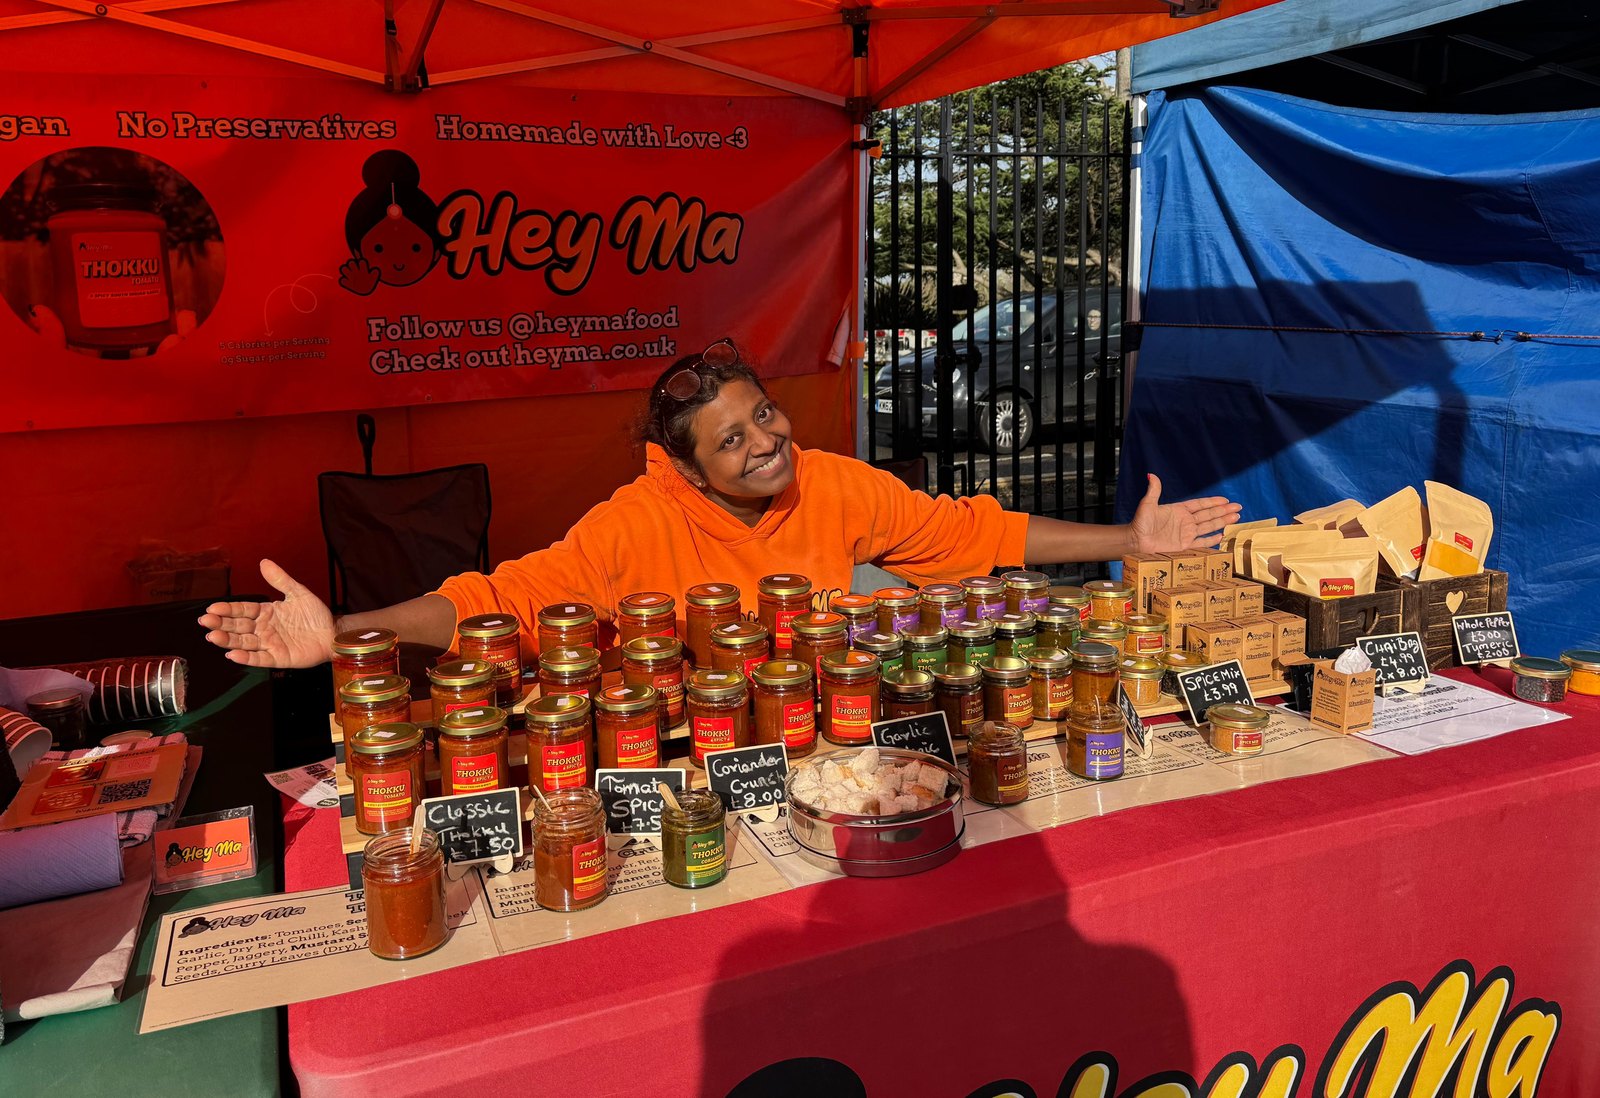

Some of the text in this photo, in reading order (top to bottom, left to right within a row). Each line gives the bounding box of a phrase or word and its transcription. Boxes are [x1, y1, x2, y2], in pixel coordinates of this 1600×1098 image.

[0, 113, 70, 141] gan
[116, 110, 396, 140] No Preservatives
[435, 113, 598, 145] Homemade
[602, 122, 661, 147] with
[664, 126, 722, 149] Love
[436, 188, 744, 296] Hey Ma
[81, 258, 160, 278] THOKKU
[367, 305, 680, 343] Follow us @heymafood
[227, 340, 271, 349] Calories
[273, 340, 290, 348] per
[292, 337, 330, 345] Serving
[236, 354, 266, 364] Sugar
[268, 353, 285, 362] per
[287, 350, 326, 359] Serving
[369, 336, 676, 375] Check out heyma.co.uk
[1456, 619, 1484, 630] Whole
[1381, 653, 1415, 668] £4.99
[1376, 668, 1387, 681] 2
[1397, 666, 1424, 678] 8.00
[1203, 683, 1238, 702] £3.99
[836, 706, 868, 715] THOKKU
[697, 729, 730, 737] THOKKU
[880, 722, 931, 744] Garlic
[621, 738, 655, 751] THOKKU
[1090, 746, 1121, 756] THOKKU
[547, 754, 582, 766] THOKKU
[712, 752, 783, 777] Coriander
[456, 766, 494, 777] THOKKU
[368, 784, 405, 795] THOKKU
[601, 776, 663, 794] Tomat
[730, 770, 785, 794] Crunch
[731, 788, 783, 809] £8.00
[428, 799, 511, 824] Classic
[611, 799, 663, 818] SPIC
[621, 817, 662, 832] £7.5
[182, 840, 243, 863] Hey Ma
[608, 861, 637, 873] nder,
[608, 874, 650, 887] esame
[610, 882, 645, 895] greek
[500, 897, 534, 908] Must
[501, 905, 530, 916] Salt,
[208, 914, 259, 931] Hey
[260, 906, 306, 921] Ma
[177, 925, 369, 965] Garlic, Dry Red Chilli, Kash
[178, 917, 368, 956] Ingredients: Tomatoes, Ses
[174, 969, 222, 983] Seeds,
[223, 960, 267, 973] Curry
[271, 950, 319, 964] Leaves
[322, 942, 361, 957] (Dry),
[176, 959, 230, 974] Pepper,
[232, 948, 288, 962] Jaggery,
[290, 935, 355, 951] Mustard
